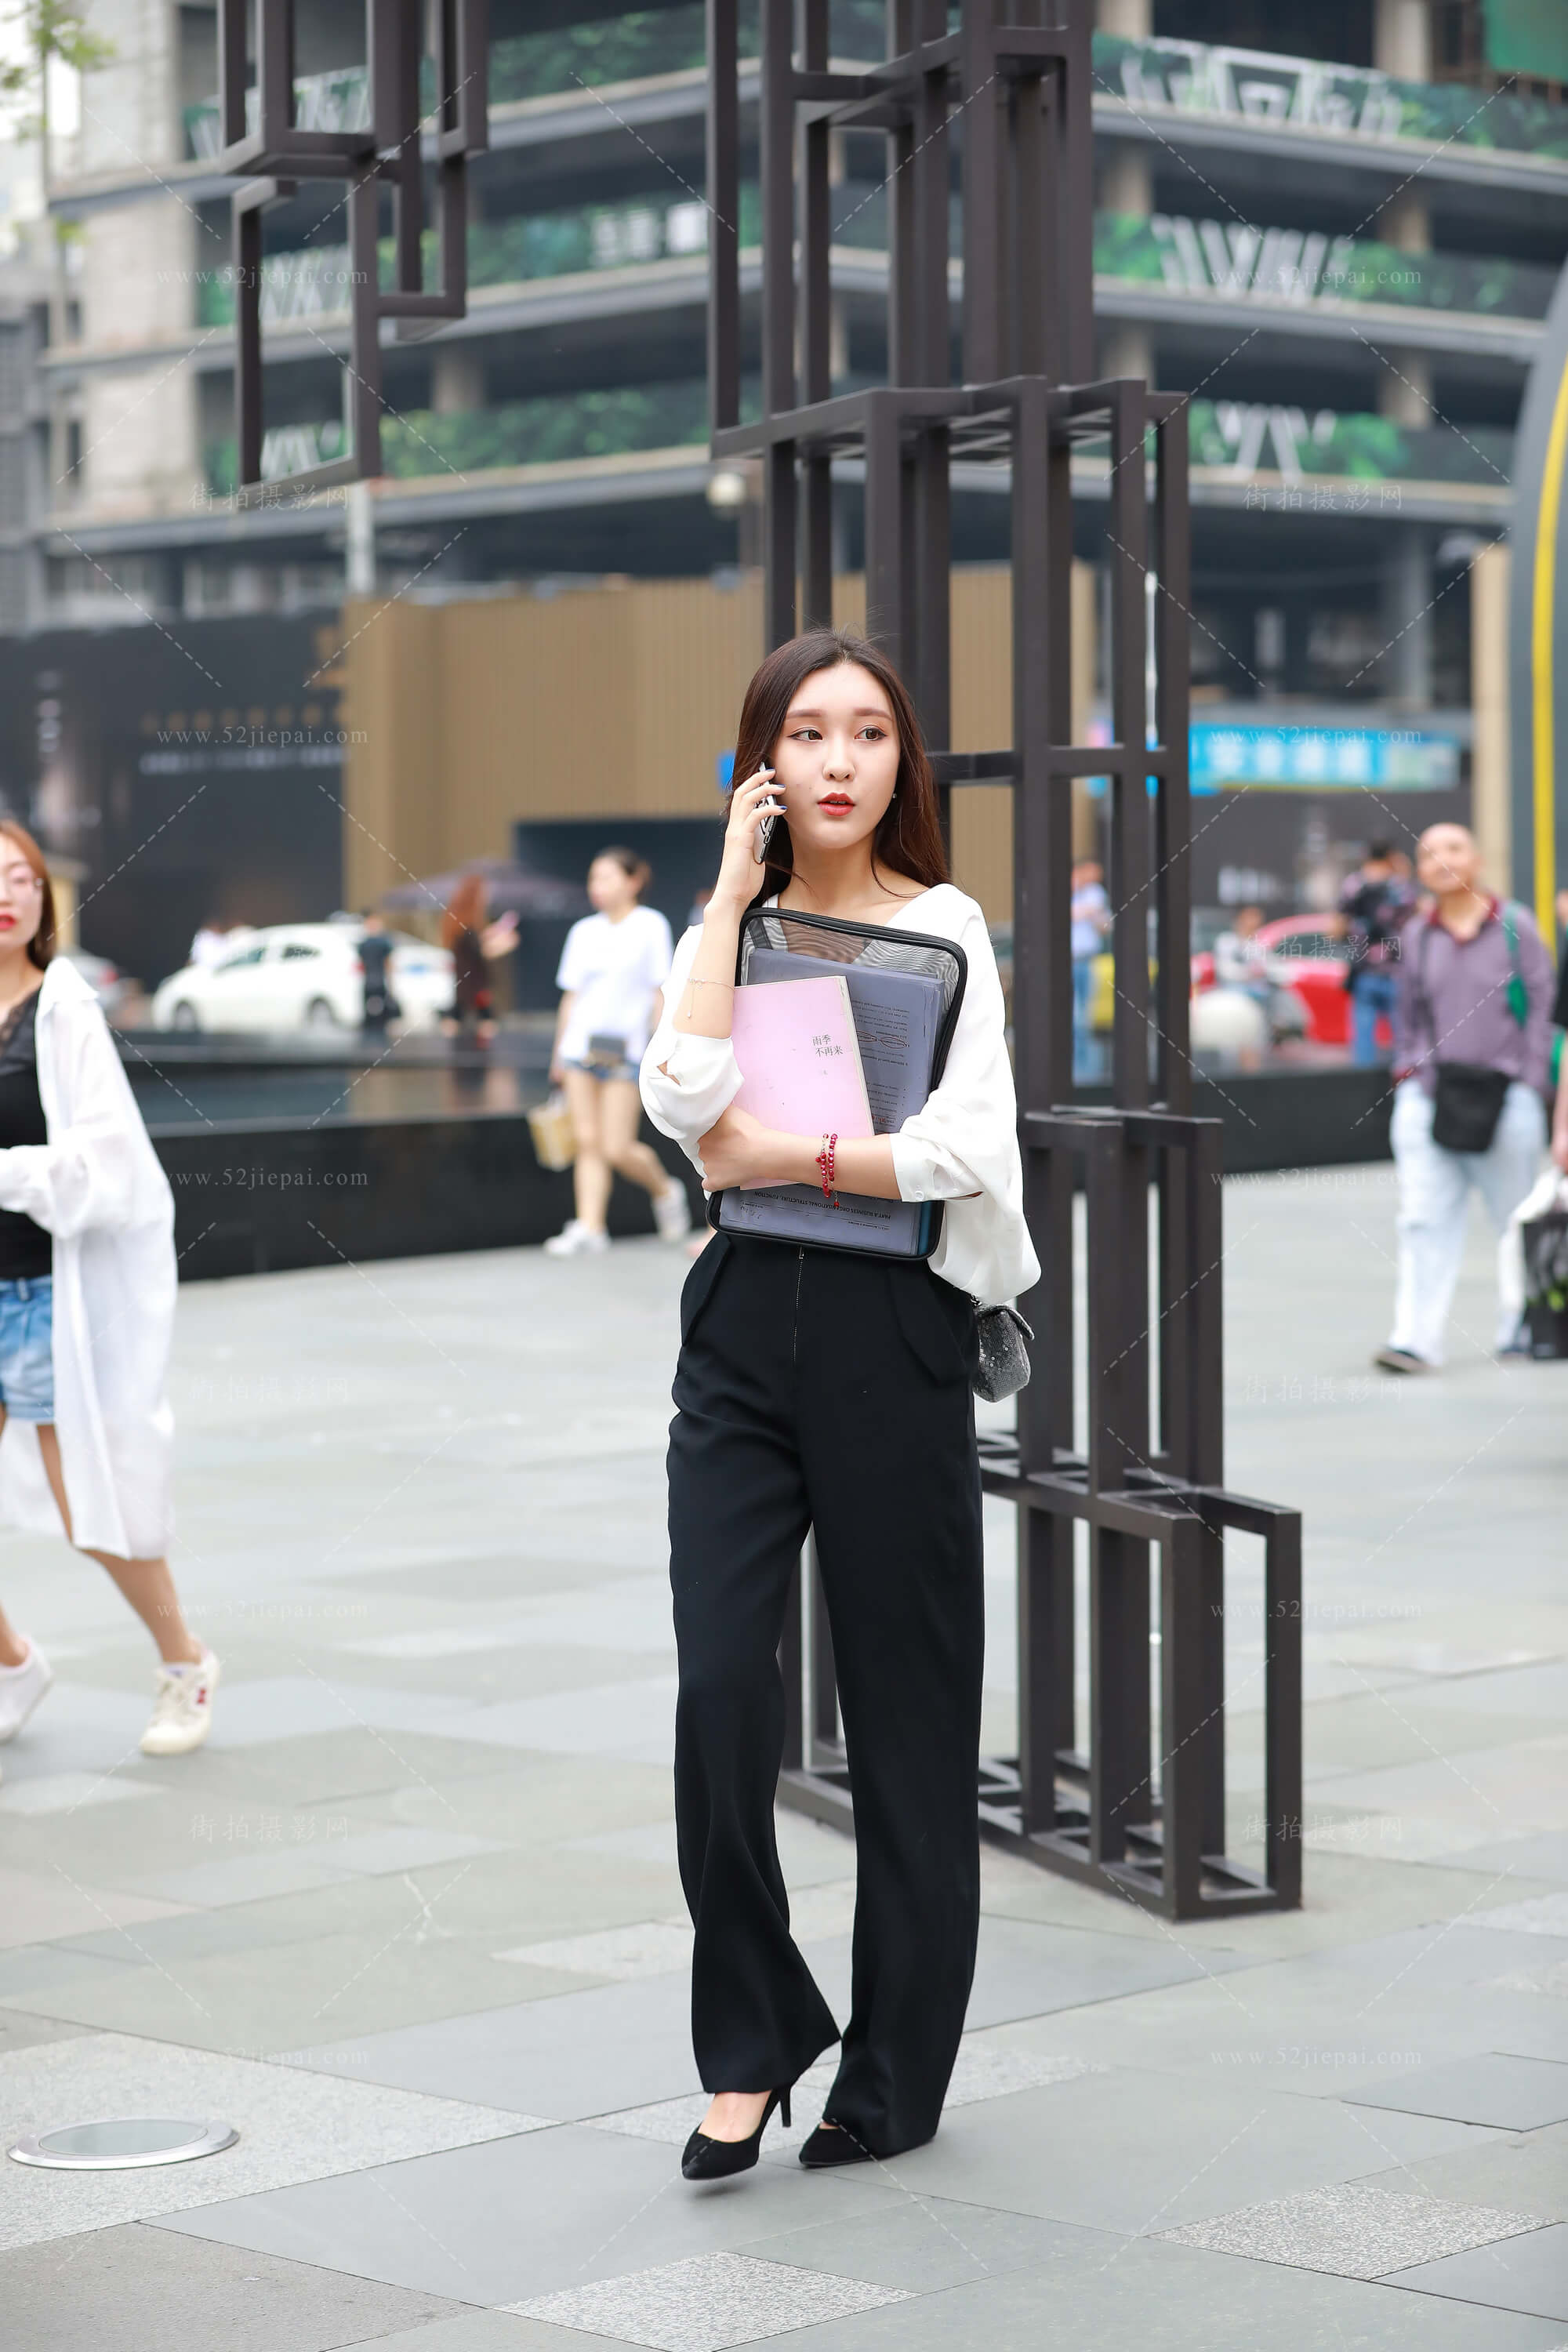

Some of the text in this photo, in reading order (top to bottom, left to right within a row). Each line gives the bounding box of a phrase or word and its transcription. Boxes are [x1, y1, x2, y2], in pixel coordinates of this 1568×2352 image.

[812, 1034, 832, 1047] 雨季
[815, 1045, 844, 1058] 不再来
